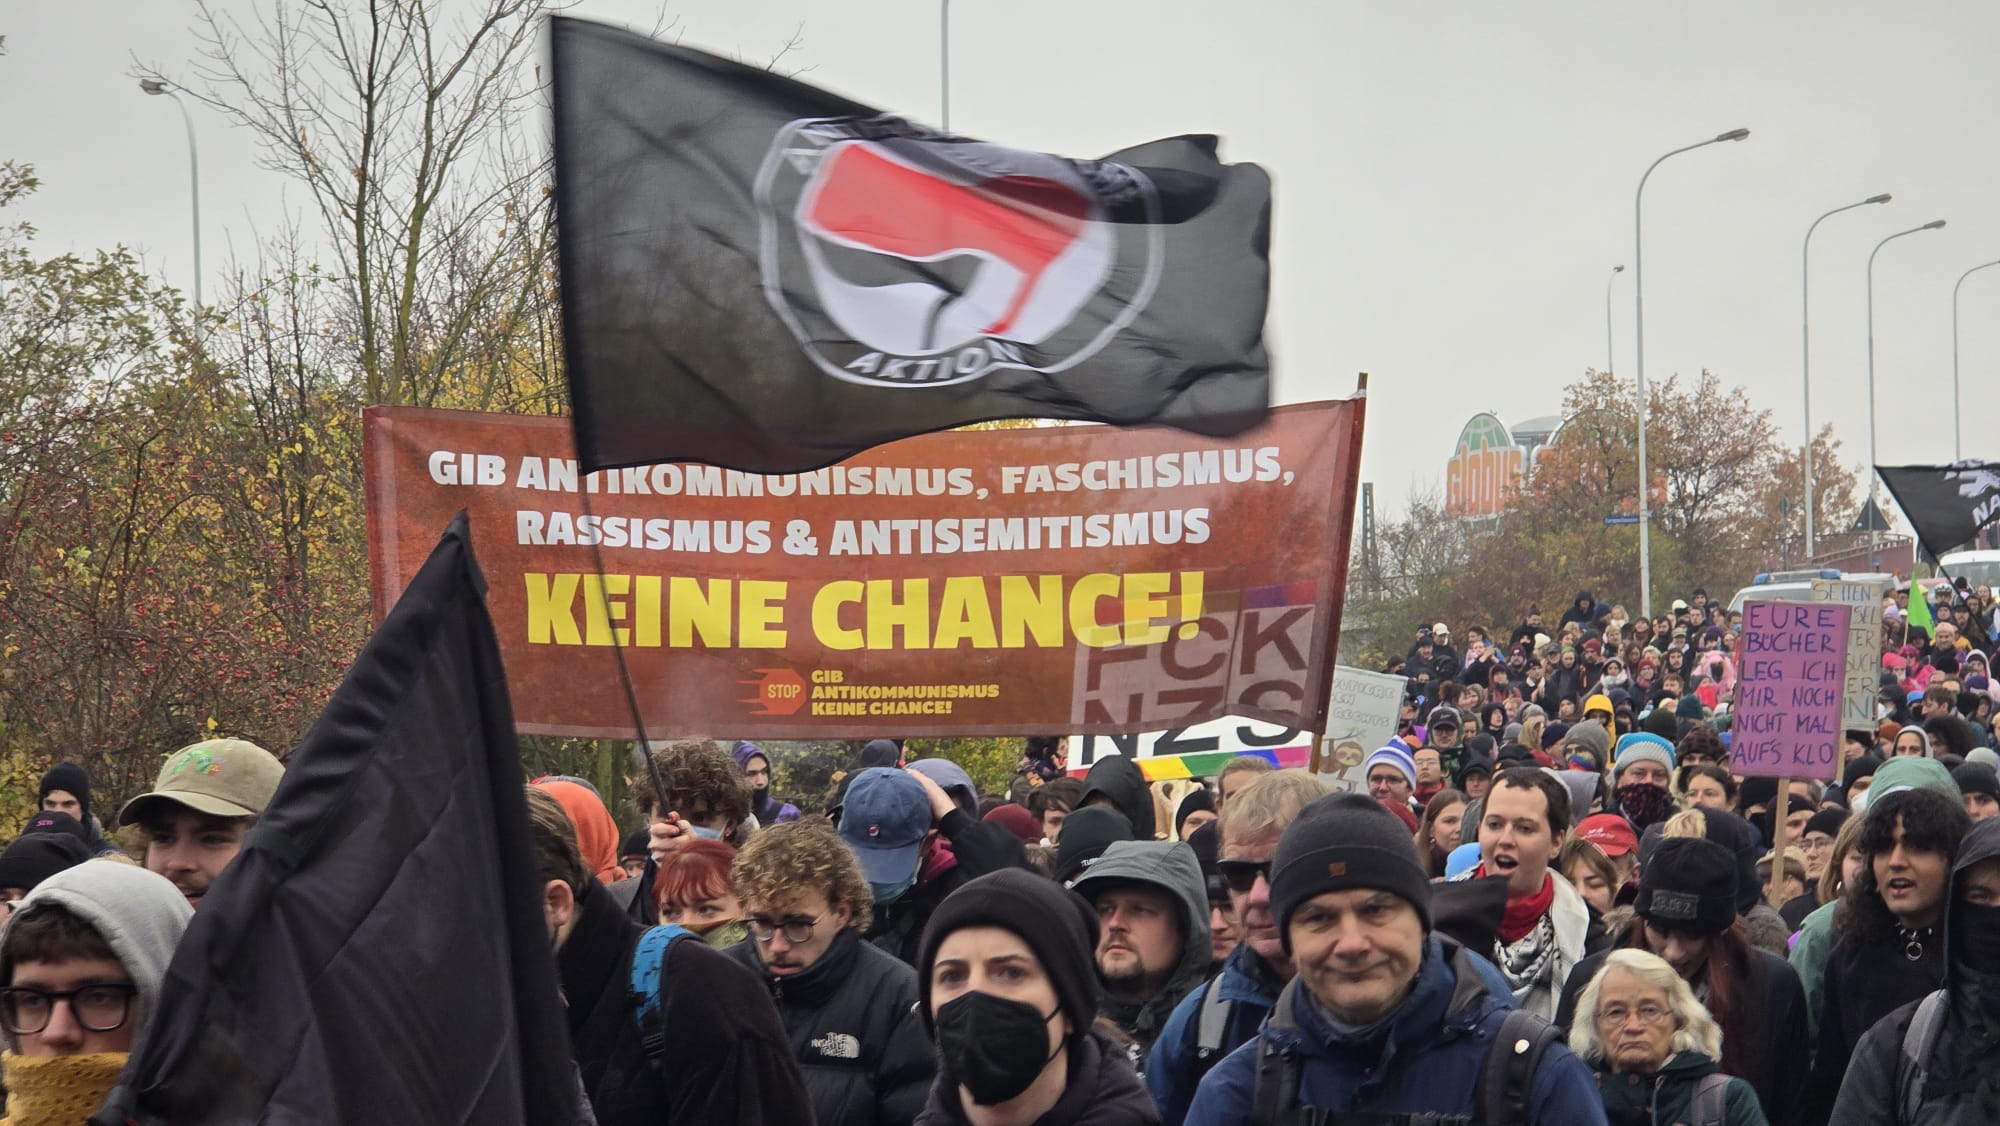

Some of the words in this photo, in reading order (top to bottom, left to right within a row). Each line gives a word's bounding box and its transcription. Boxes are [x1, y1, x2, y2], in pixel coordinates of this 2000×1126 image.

[844, 338, 1026, 380] AKTION
[428, 450, 506, 486] GIB
[1001, 446, 1295, 494] FASCHISMUS,
[516, 510, 771, 554] RASSISMUS
[782, 519, 818, 556] &
[829, 507, 1211, 556] ANTISEMITISMUS
[524, 573, 788, 649] KEINE
[811, 571, 1204, 650] CHANCE!
[1750, 604, 1836, 629] EURE
[1087, 605, 1314, 692] FCK
[811, 670, 844, 683] GIB
[1741, 660, 1783, 681] LEG
[1801, 661, 1836, 681] ICH
[768, 684, 800, 699] STOP
[811, 684, 1000, 699] ANTIKOMMUNISMUS
[1740, 686, 1778, 707] MIR
[1792, 687, 1835, 707] NOCH
[811, 701, 866, 715] KEINE
[869, 700, 952, 715] CHANCE!
[1081, 679, 1305, 766] NZS
[1737, 712, 1788, 734] NICHT
[1796, 714, 1834, 734] MAL
[1793, 743, 1834, 765] KLO
